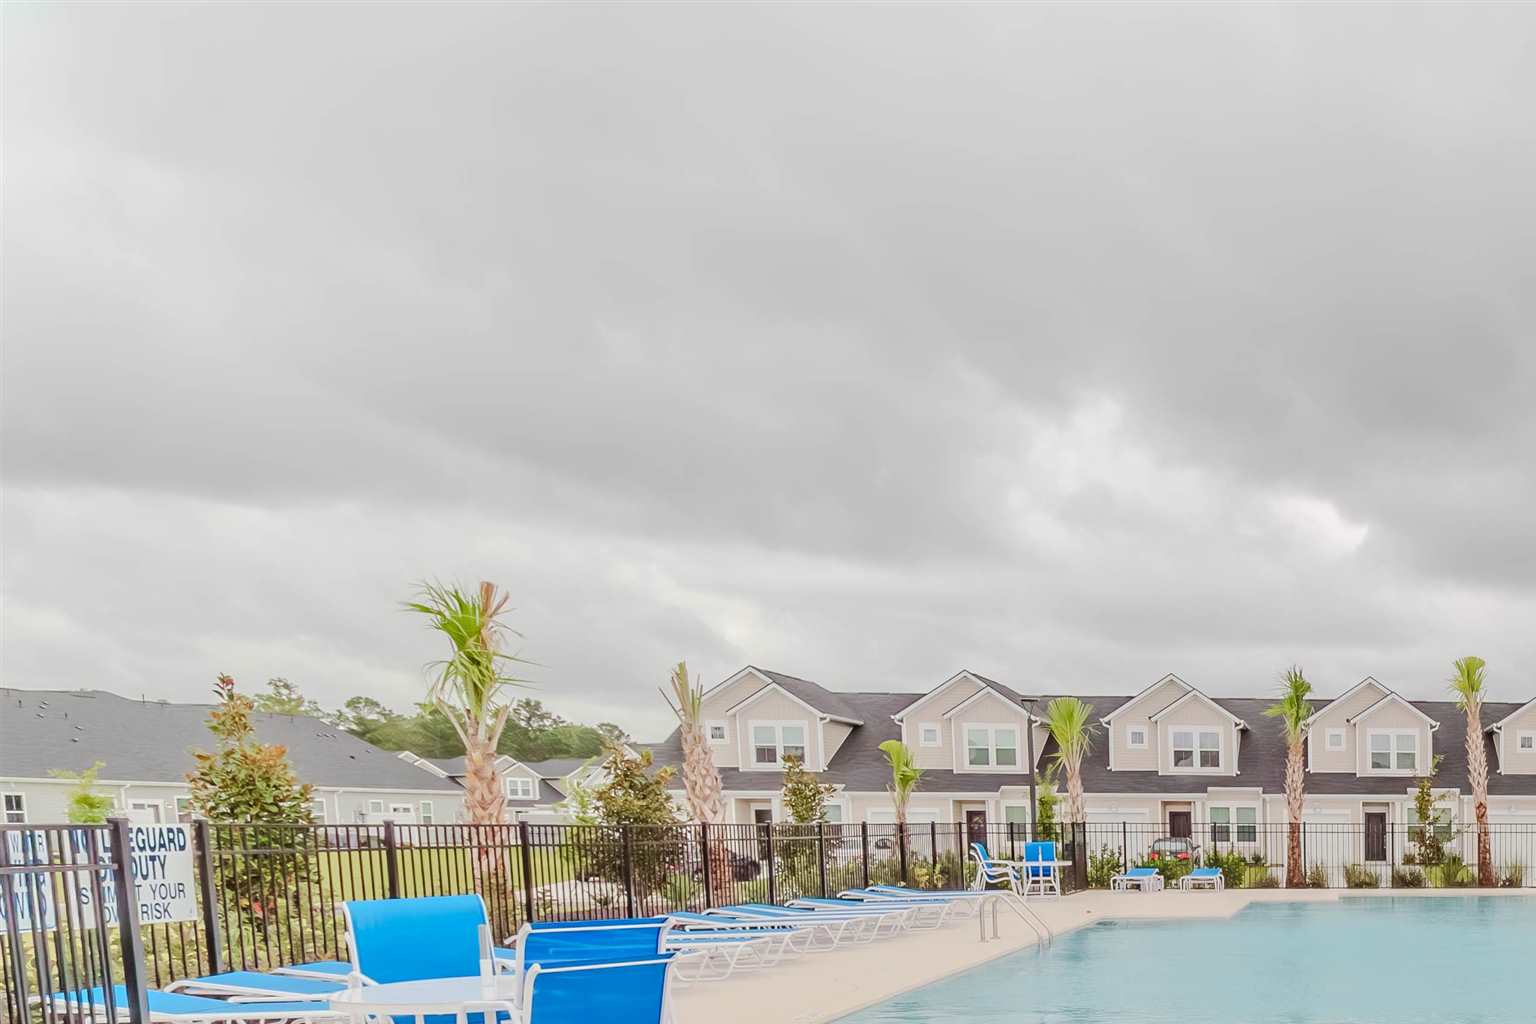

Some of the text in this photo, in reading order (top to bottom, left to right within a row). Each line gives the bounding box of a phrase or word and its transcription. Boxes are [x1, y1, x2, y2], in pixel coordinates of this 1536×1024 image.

[102, 827, 187, 853] LEGUARD
[150, 882, 186, 900] YOUR
[140, 902, 173, 921] RISK
